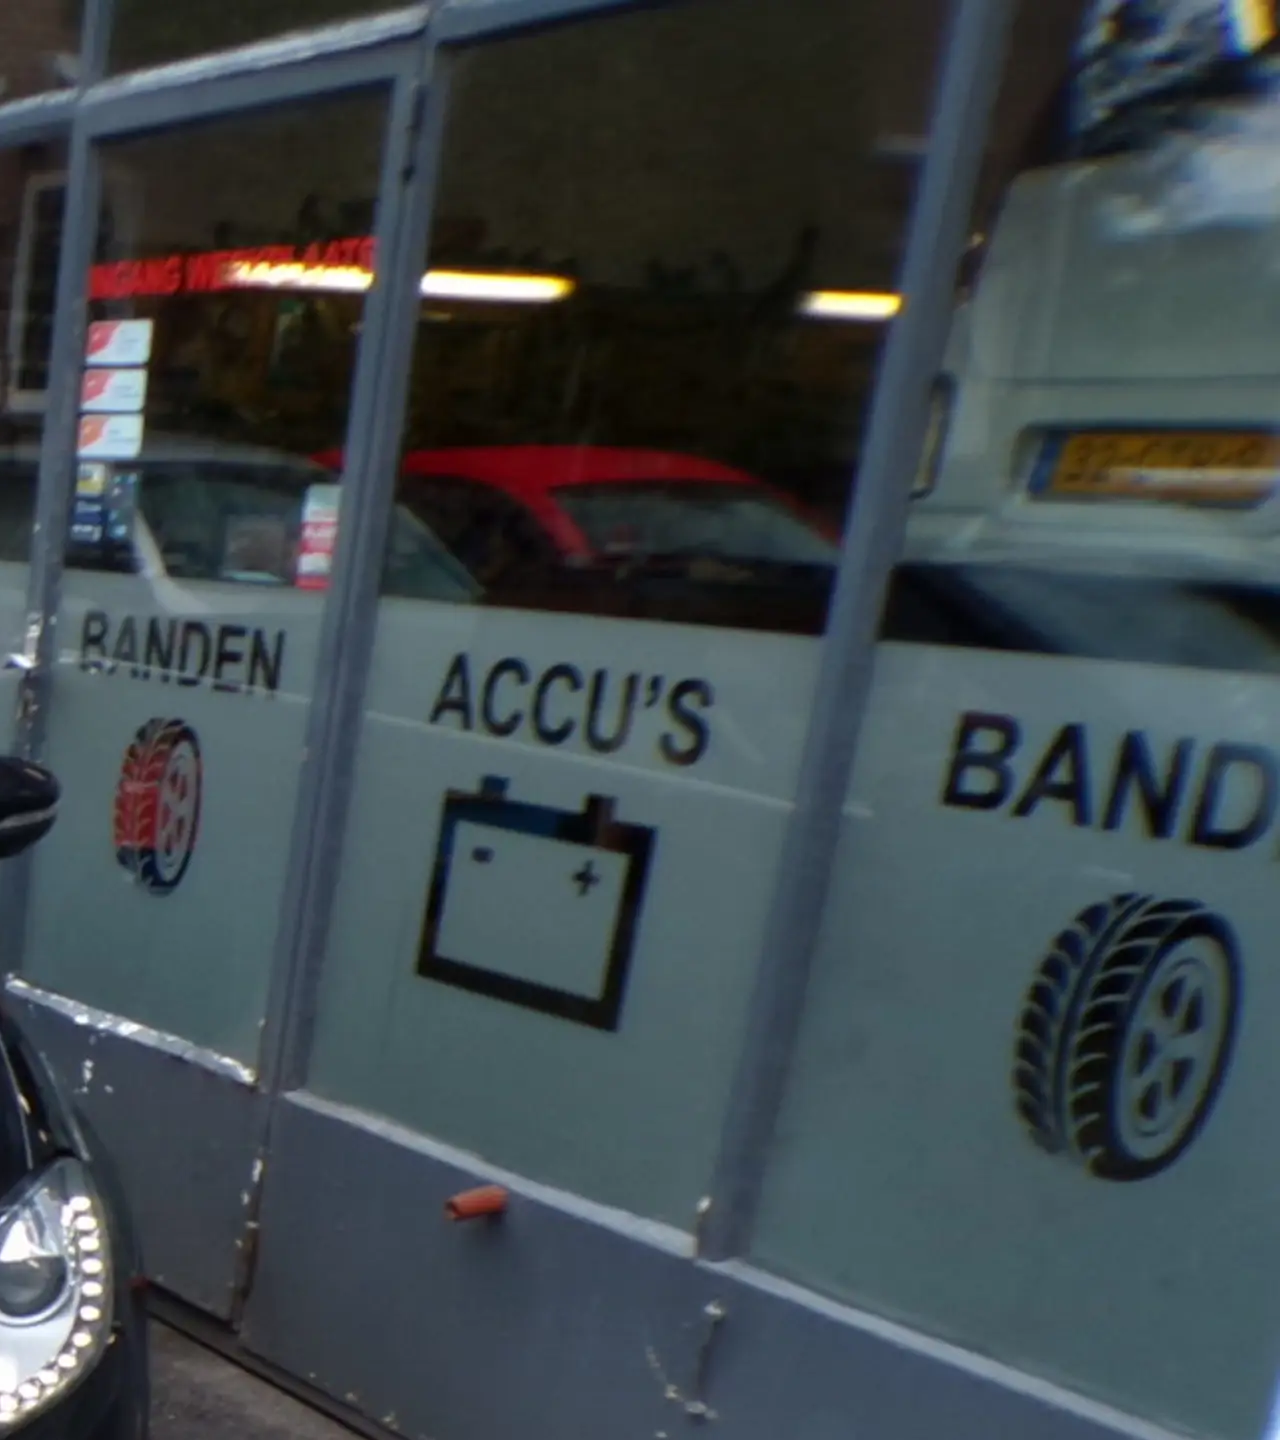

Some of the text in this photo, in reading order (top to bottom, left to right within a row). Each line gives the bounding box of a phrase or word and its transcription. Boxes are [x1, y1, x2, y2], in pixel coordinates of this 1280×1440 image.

[80, 610, 286, 693] BANDEN
[428, 652, 714, 767] ACCU'S
[939, 710, 1280, 856] BAND
